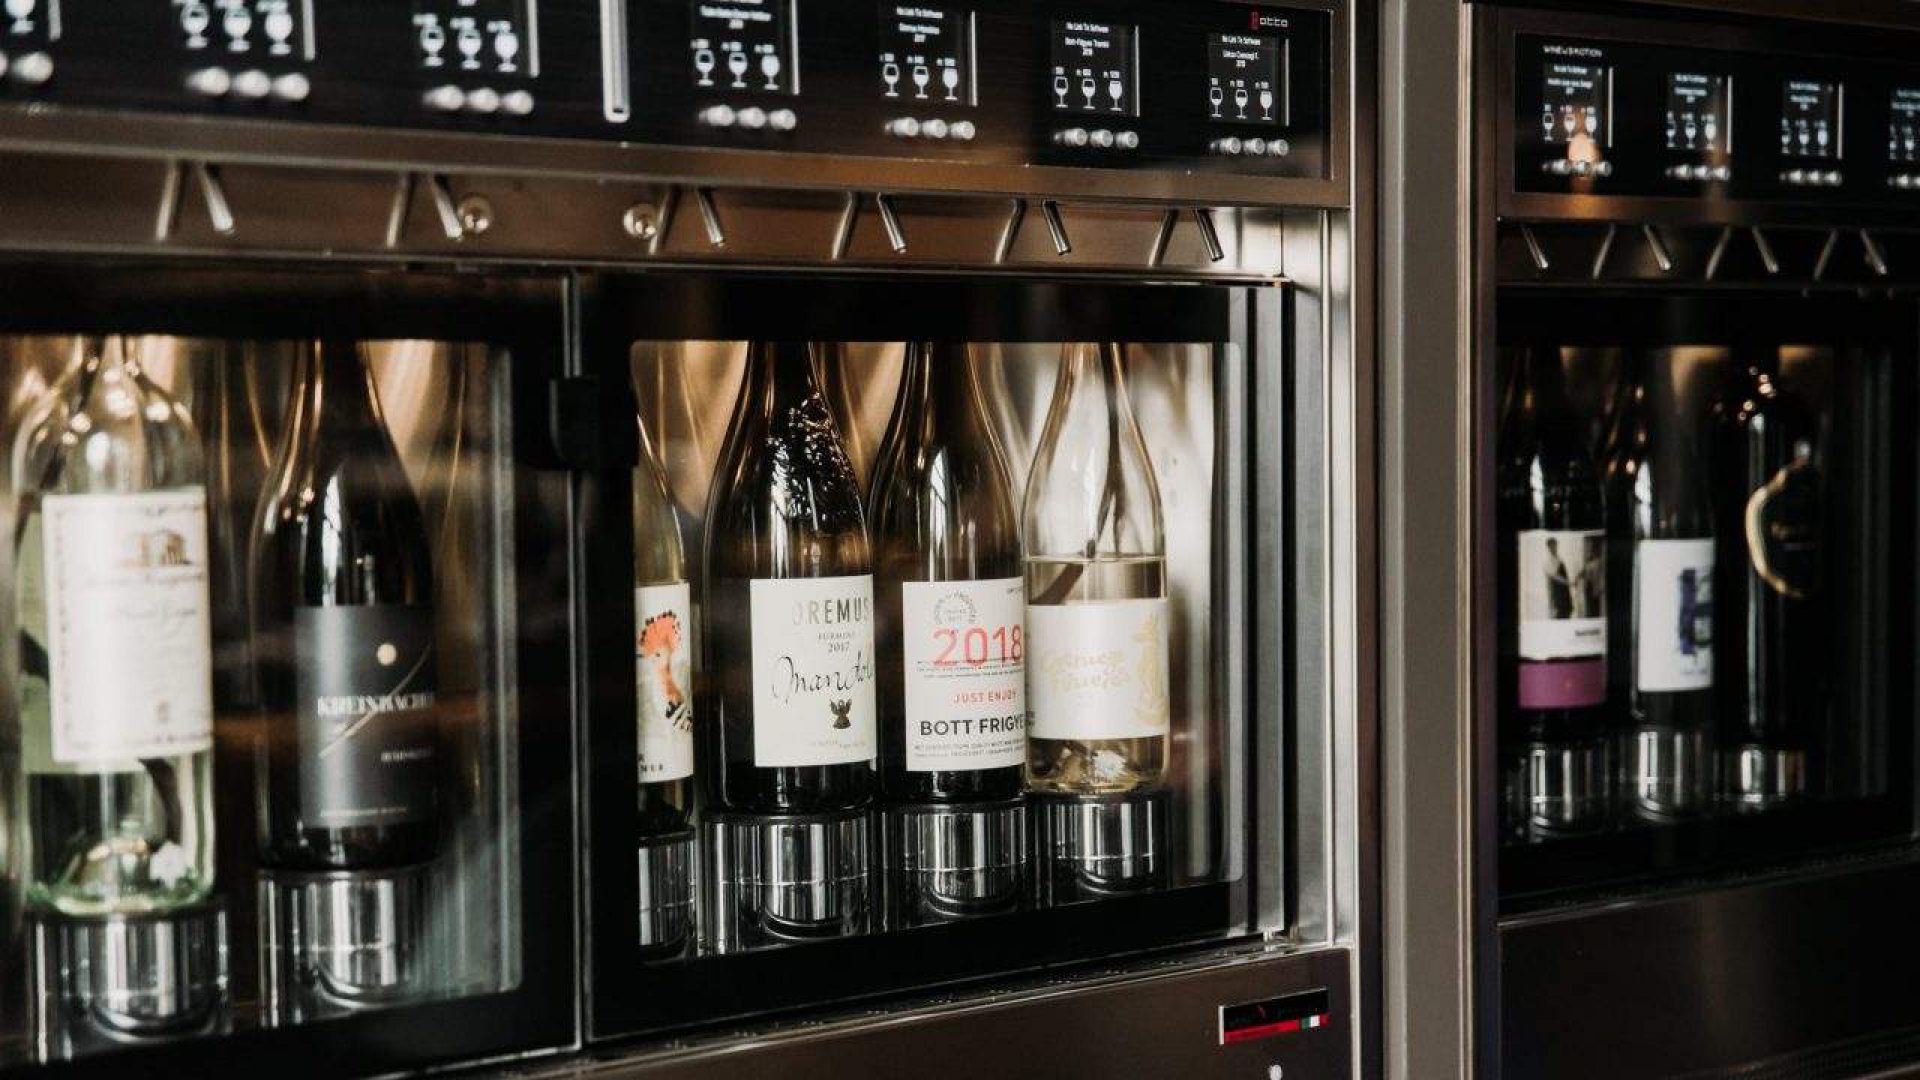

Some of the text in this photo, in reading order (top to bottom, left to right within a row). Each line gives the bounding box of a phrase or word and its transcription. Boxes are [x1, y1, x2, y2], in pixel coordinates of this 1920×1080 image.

[1259, 16, 1288, 28] otto
[828, 642, 850, 653] 2017
[932, 624, 1022, 667] 2018
[954, 688, 1017, 704] JUST ENJOY
[920, 719, 973, 736] BOTT
